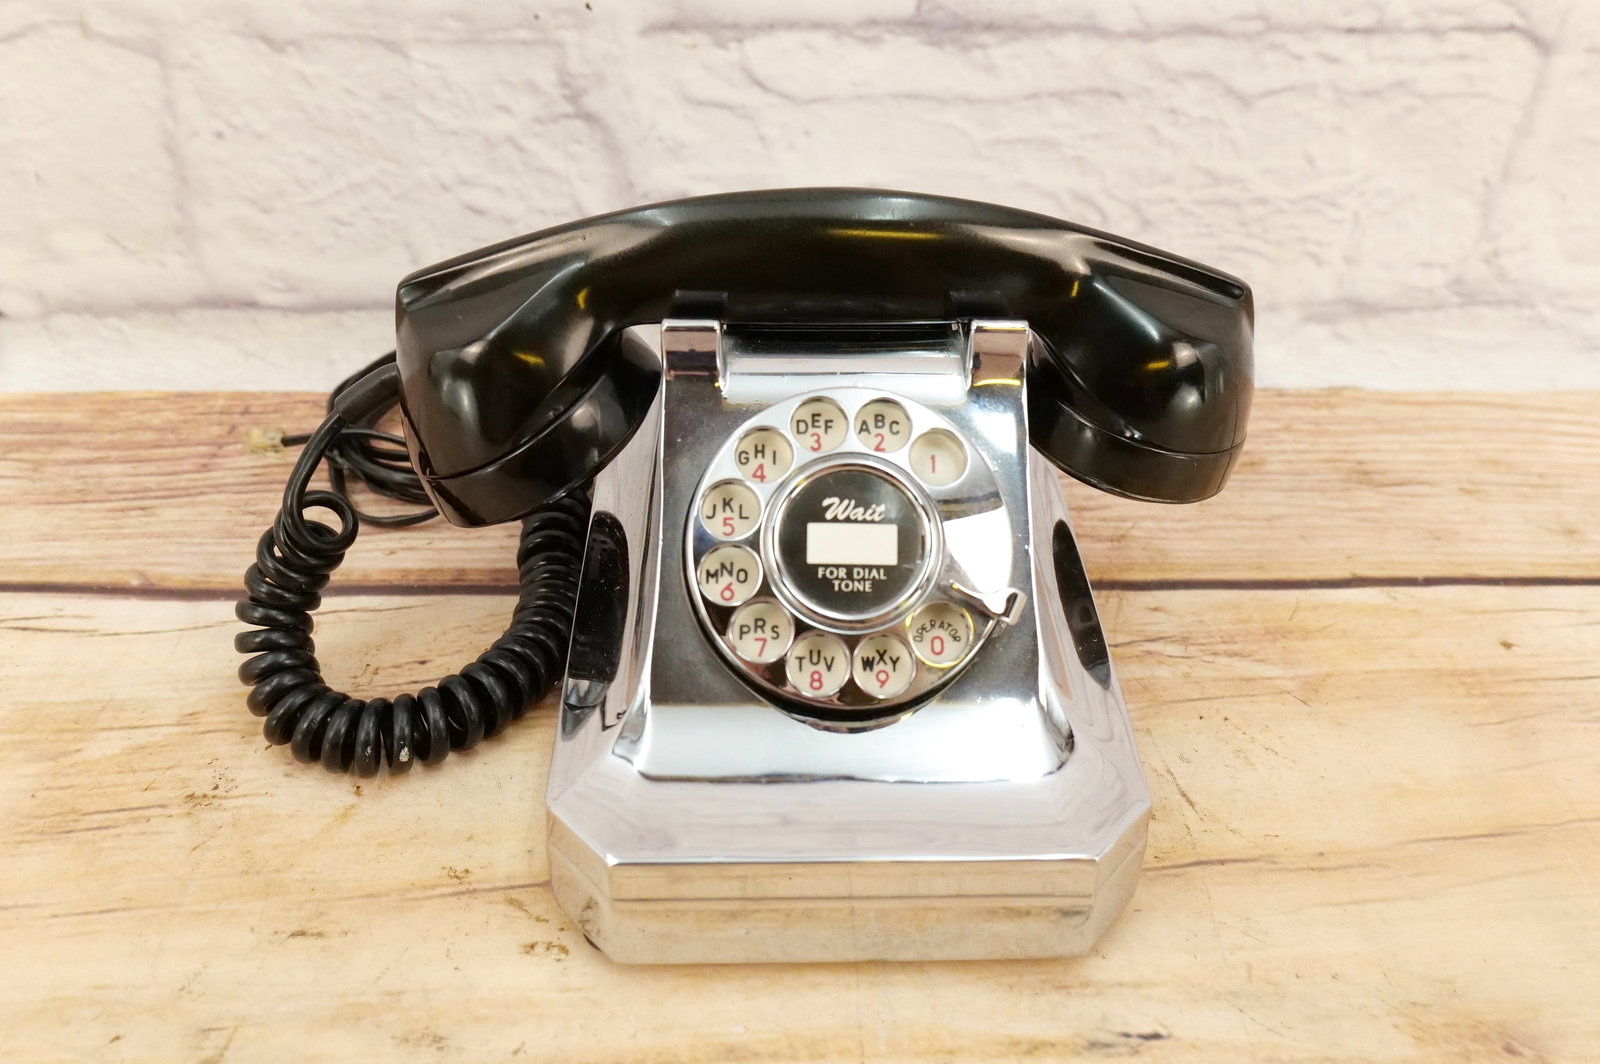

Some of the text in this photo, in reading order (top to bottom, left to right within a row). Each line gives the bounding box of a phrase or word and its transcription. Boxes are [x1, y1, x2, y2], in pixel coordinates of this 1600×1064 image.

[796, 413, 834, 435] DEF
[858, 413, 900, 436] ABC
[810, 433, 822, 452] 3
[874, 433, 886, 452] 2
[738, 444, 777, 465] GHI
[929, 454, 936, 474] 1
[752, 463, 767, 482] 4
[706, 497, 750, 520] JKL
[822, 496, 886, 522] Wait
[722, 517, 735, 536] 5
[706, 562, 748, 584] MNO
[817, 566, 887, 580] FOR DIAL
[720, 582, 735, 601] 6
[832, 580, 873, 592] TONE
[739, 618, 780, 640] PRS
[913, 618, 962, 643] OPERATOR
[754, 637, 768, 657] 7
[930, 635, 945, 656] 0
[795, 649, 835, 673] TUV
[861, 649, 900, 673] WXY
[809, 670, 823, 691] 8
[875, 669, 889, 689] 9
